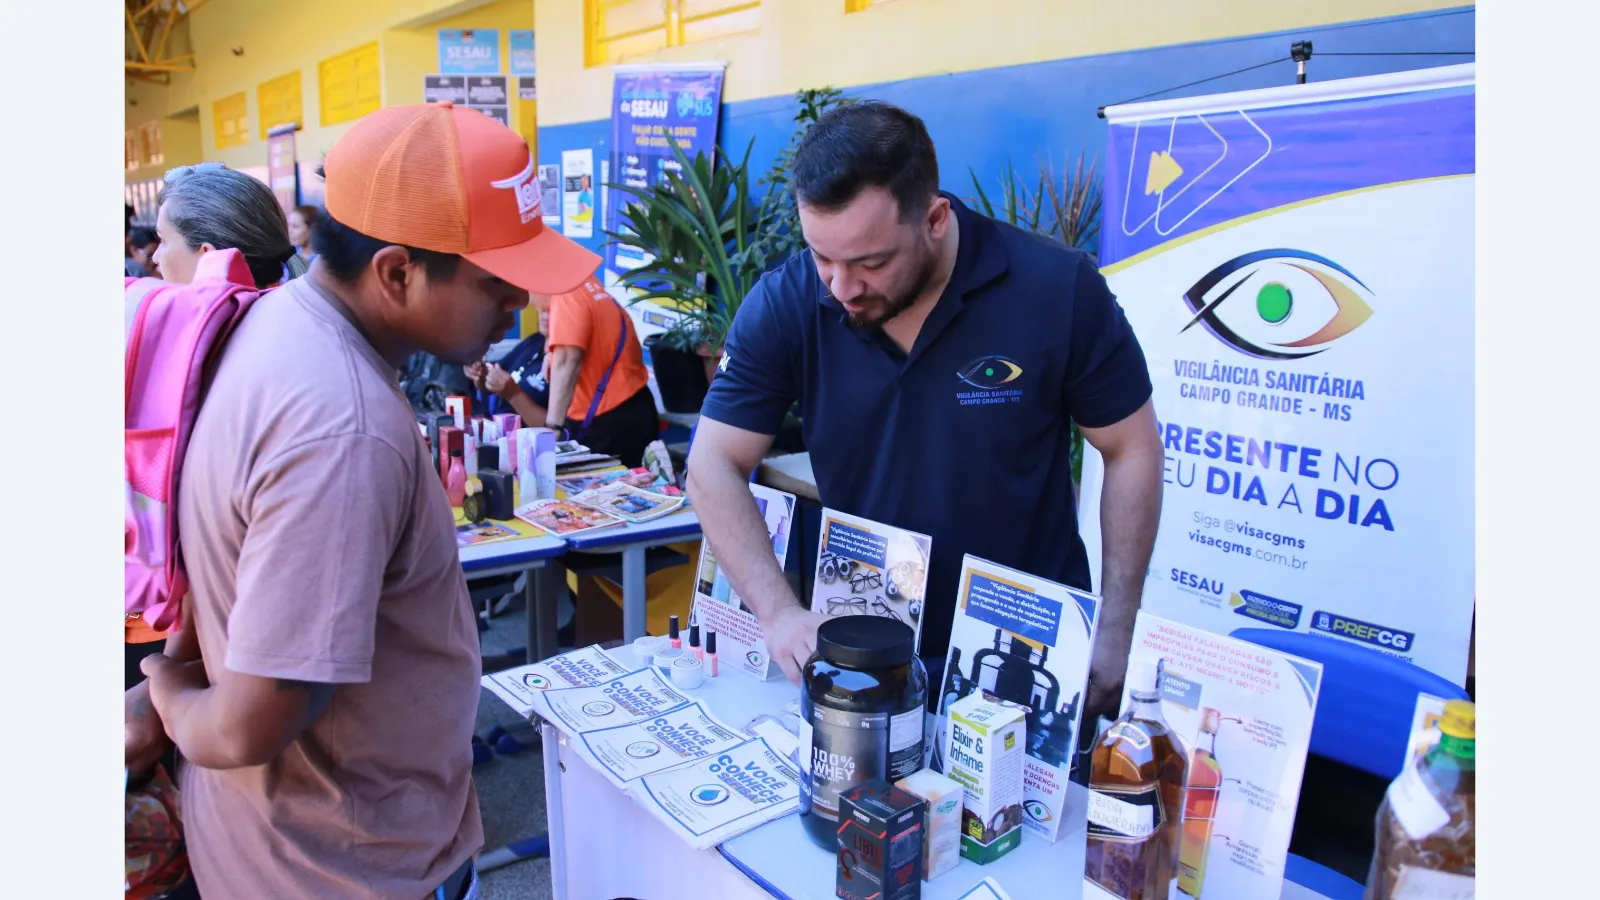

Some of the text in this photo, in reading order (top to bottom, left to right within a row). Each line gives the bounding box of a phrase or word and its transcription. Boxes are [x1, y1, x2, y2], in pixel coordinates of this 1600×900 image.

[630, 100, 668, 118] SESAU
[1174, 359, 1365, 400] VIGILÂNCIA SANITÁRIA
[956, 391, 990, 399] VIGILÂNCIA
[1180, 383, 1231, 404] CAMPO
[1237, 391, 1303, 415] GRANDE
[1323, 403, 1352, 422] MS
[1333, 452, 1399, 490] NO
[1163, 456, 1395, 531] EU DIA A DIA
[1193, 510, 1305, 549] Siga @visacgms
[1188, 530, 1308, 571] visacgms.com.br
[1171, 568, 1224, 595] SESAU
[1333, 618, 1407, 648] PREFCG
[1143, 639, 1272, 686] PODEM CAUSAR GRAVES RISCOS
[1195, 636, 1253, 660] FALSIFICADAS
[1255, 654, 1273, 667] SÃO
[1196, 647, 1217, 659] PARA
[1228, 657, 1271, 676] CONSUMO
[556, 656, 600, 687] CONHECE
[576, 658, 608, 678] VOCÊ
[1196, 666, 1225, 681] MESMO
[633, 685, 667, 706] VOCÊ
[1164, 686, 1184, 697] SINAIS
[1165, 677, 1190, 690] ATENTO
[610, 681, 660, 717] CONHECE
[654, 718, 710, 758] CONHECE
[678, 722, 716, 746] VOCÊ
[953, 723, 983, 754] Elixir &
[709, 763, 722, 772] O
[814, 746, 855, 769] 100%
[814, 758, 855, 780] WHEY
[950, 741, 984, 772] Inhame
[1028, 763, 1054, 778] ALEGAM
[718, 754, 784, 804] CONHECE
[744, 760, 788, 790] VOCÊ
[1024, 778, 1052, 795] ENTA UM
[1030, 773, 1060, 790] DOENÇAS
